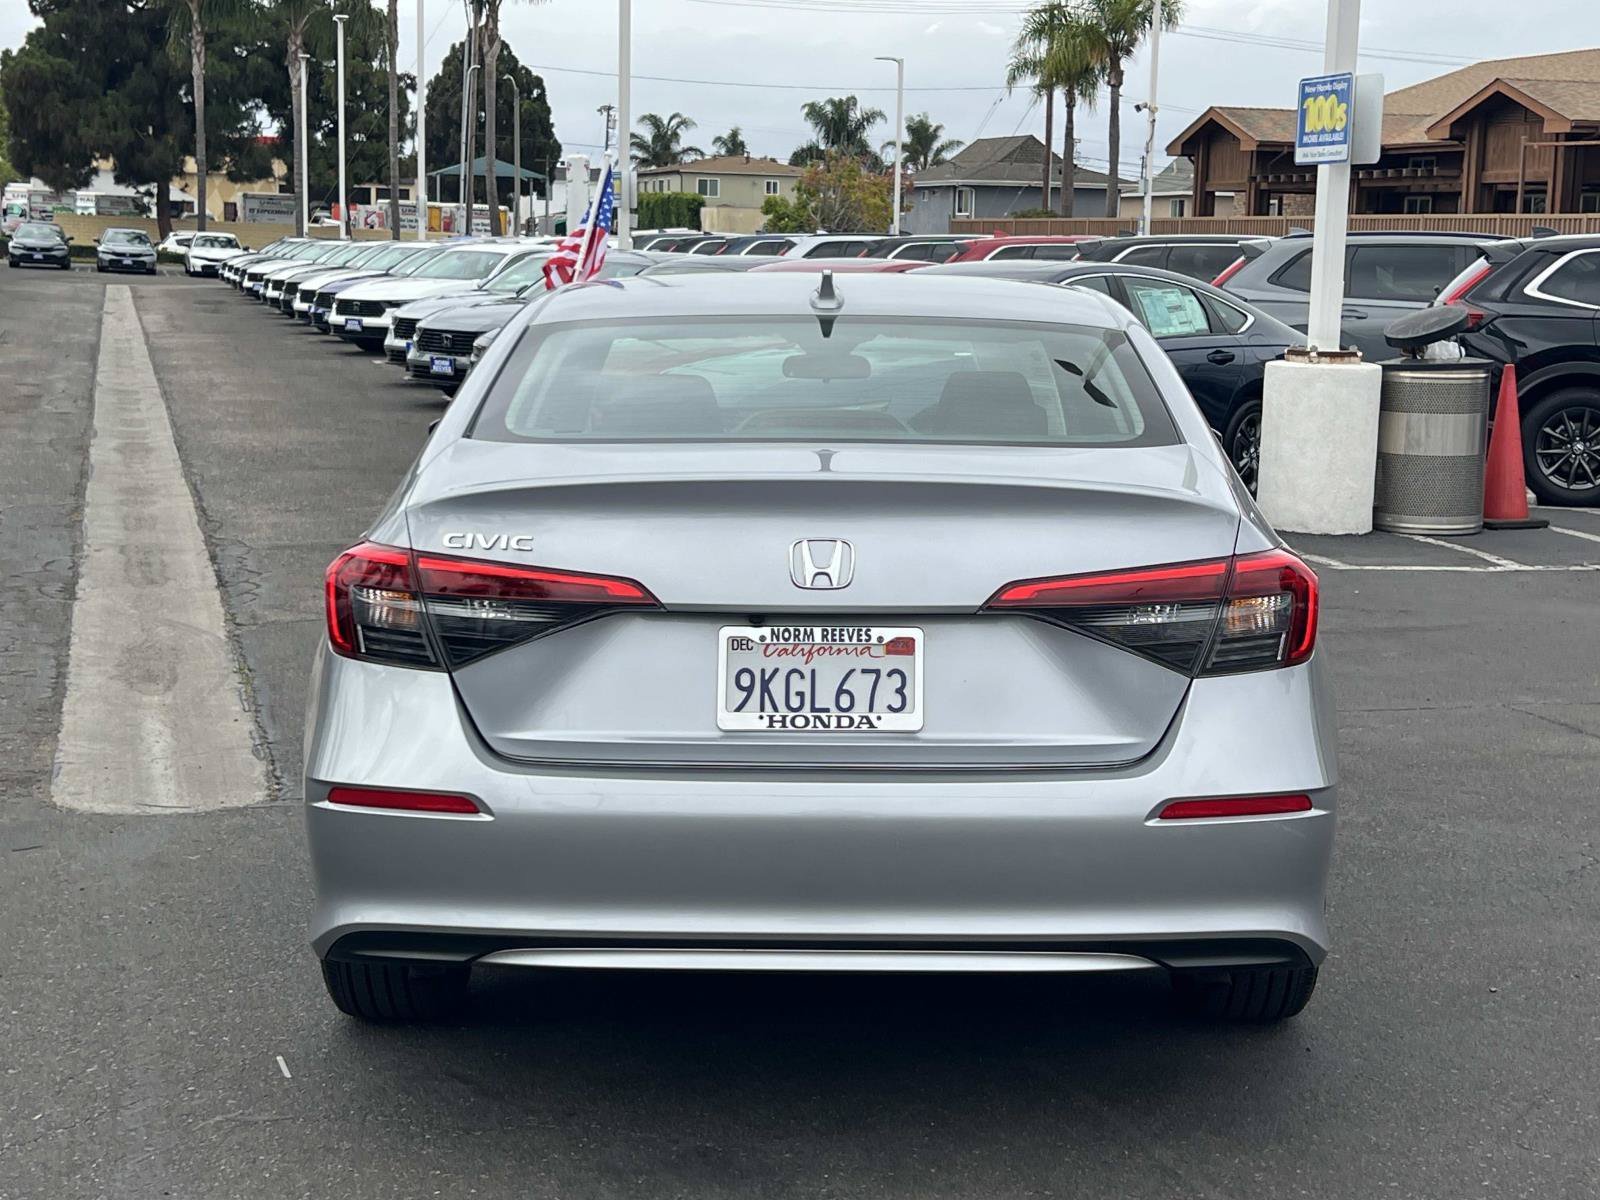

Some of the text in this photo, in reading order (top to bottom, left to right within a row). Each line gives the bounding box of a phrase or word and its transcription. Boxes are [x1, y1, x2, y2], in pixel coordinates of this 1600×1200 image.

[1304, 85, 1316, 94] New
[1303, 94, 1347, 133] 100s
[443, 532, 534, 551] CIVIC
[770, 627, 872, 643] NORM REEVES
[731, 638, 754, 651] DEC
[763, 643, 886, 665] California
[734, 668, 907, 713] 9KGL673
[766, 714, 878, 729] HONDA
